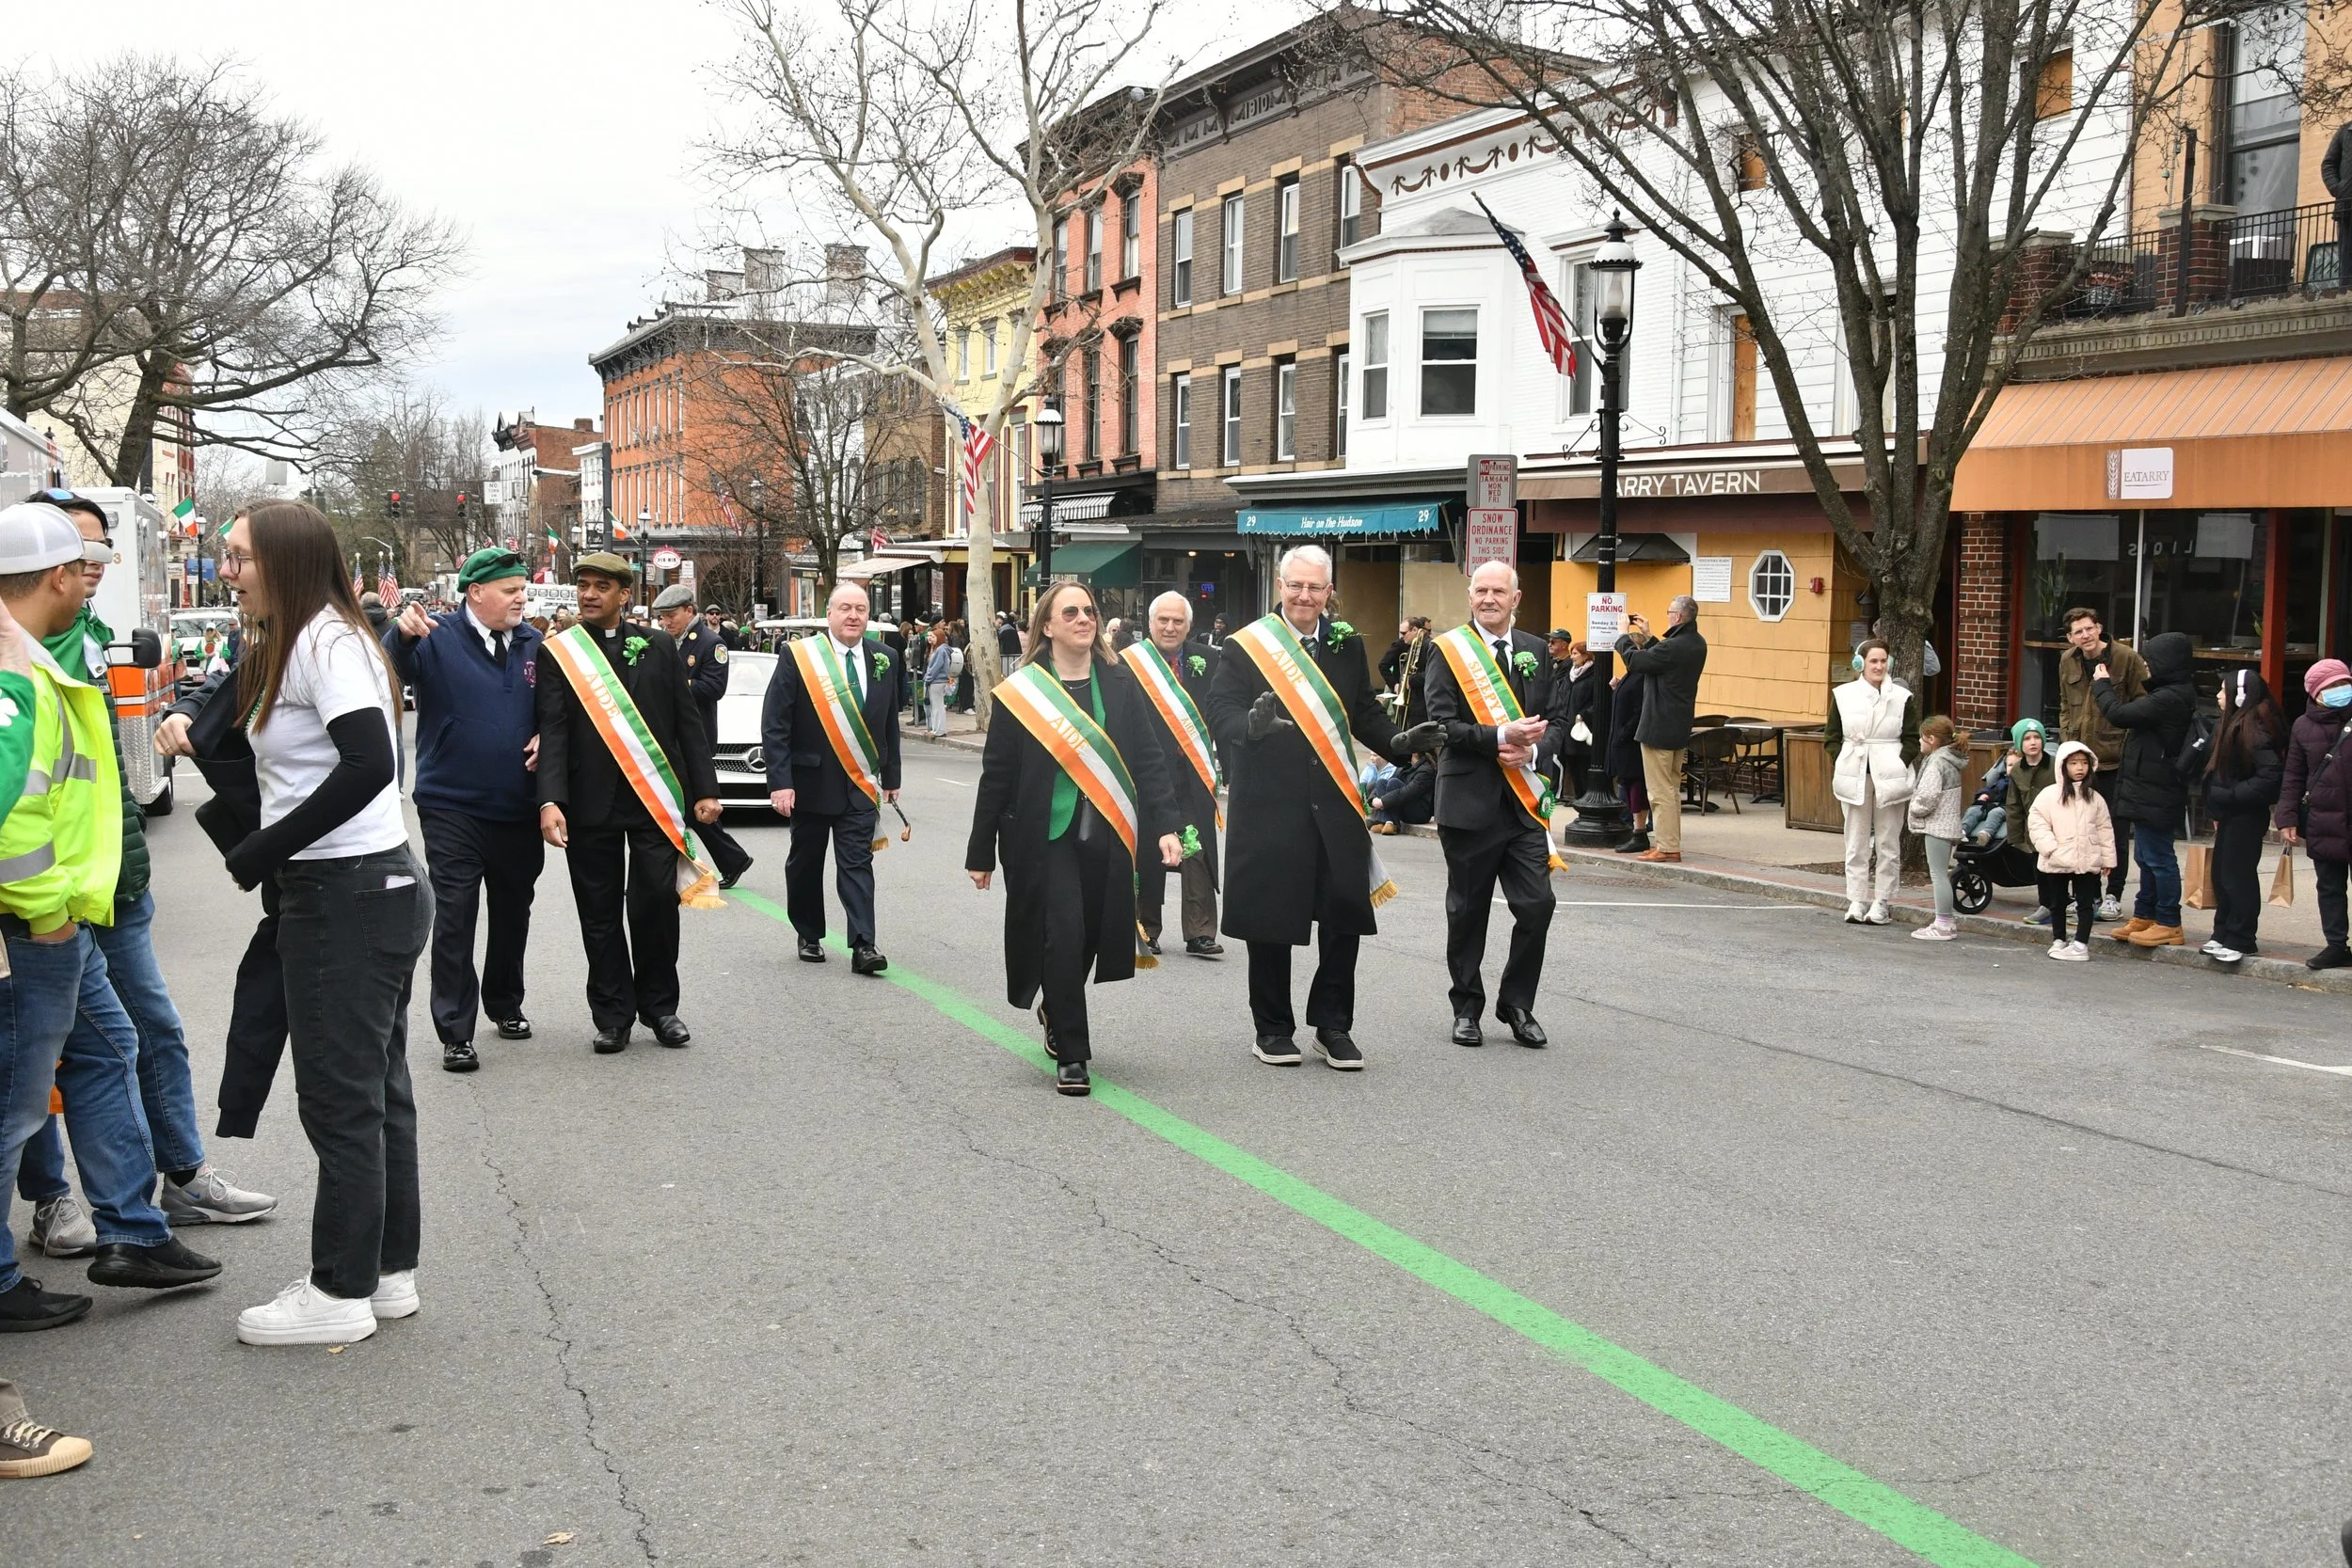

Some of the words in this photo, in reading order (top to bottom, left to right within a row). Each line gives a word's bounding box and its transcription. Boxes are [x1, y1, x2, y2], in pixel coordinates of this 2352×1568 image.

[1245, 94, 1269, 119] 1910
[1481, 462, 1489, 473] NO
[2123, 470, 2169, 483] EATARRY
[1615, 474, 1666, 496] ARRY
[1671, 470, 1760, 496] TAVERN
[1246, 515, 1257, 527] 29
[1301, 516, 1315, 529] Hair
[1325, 516, 1336, 528] the
[1337, 515, 1363, 528] Hudson
[1418, 510, 1430, 523] 29
[1482, 513, 1503, 523] SNOW
[1471, 525, 1513, 535] ORDINANCE
[1471, 556, 1492, 564] DURING
[1494, 556, 1510, 564] SNOW
[1200, 583, 1215, 592] OPEN
[1270, 650, 1308, 687] AIDE
[585, 673, 622, 719] AIDE
[817, 676, 840, 708] AIDE
[1468, 661, 1502, 710] SLEEPY
[1048, 717, 1090, 755] AIDE
[1180, 718, 1199, 741] AIDE
